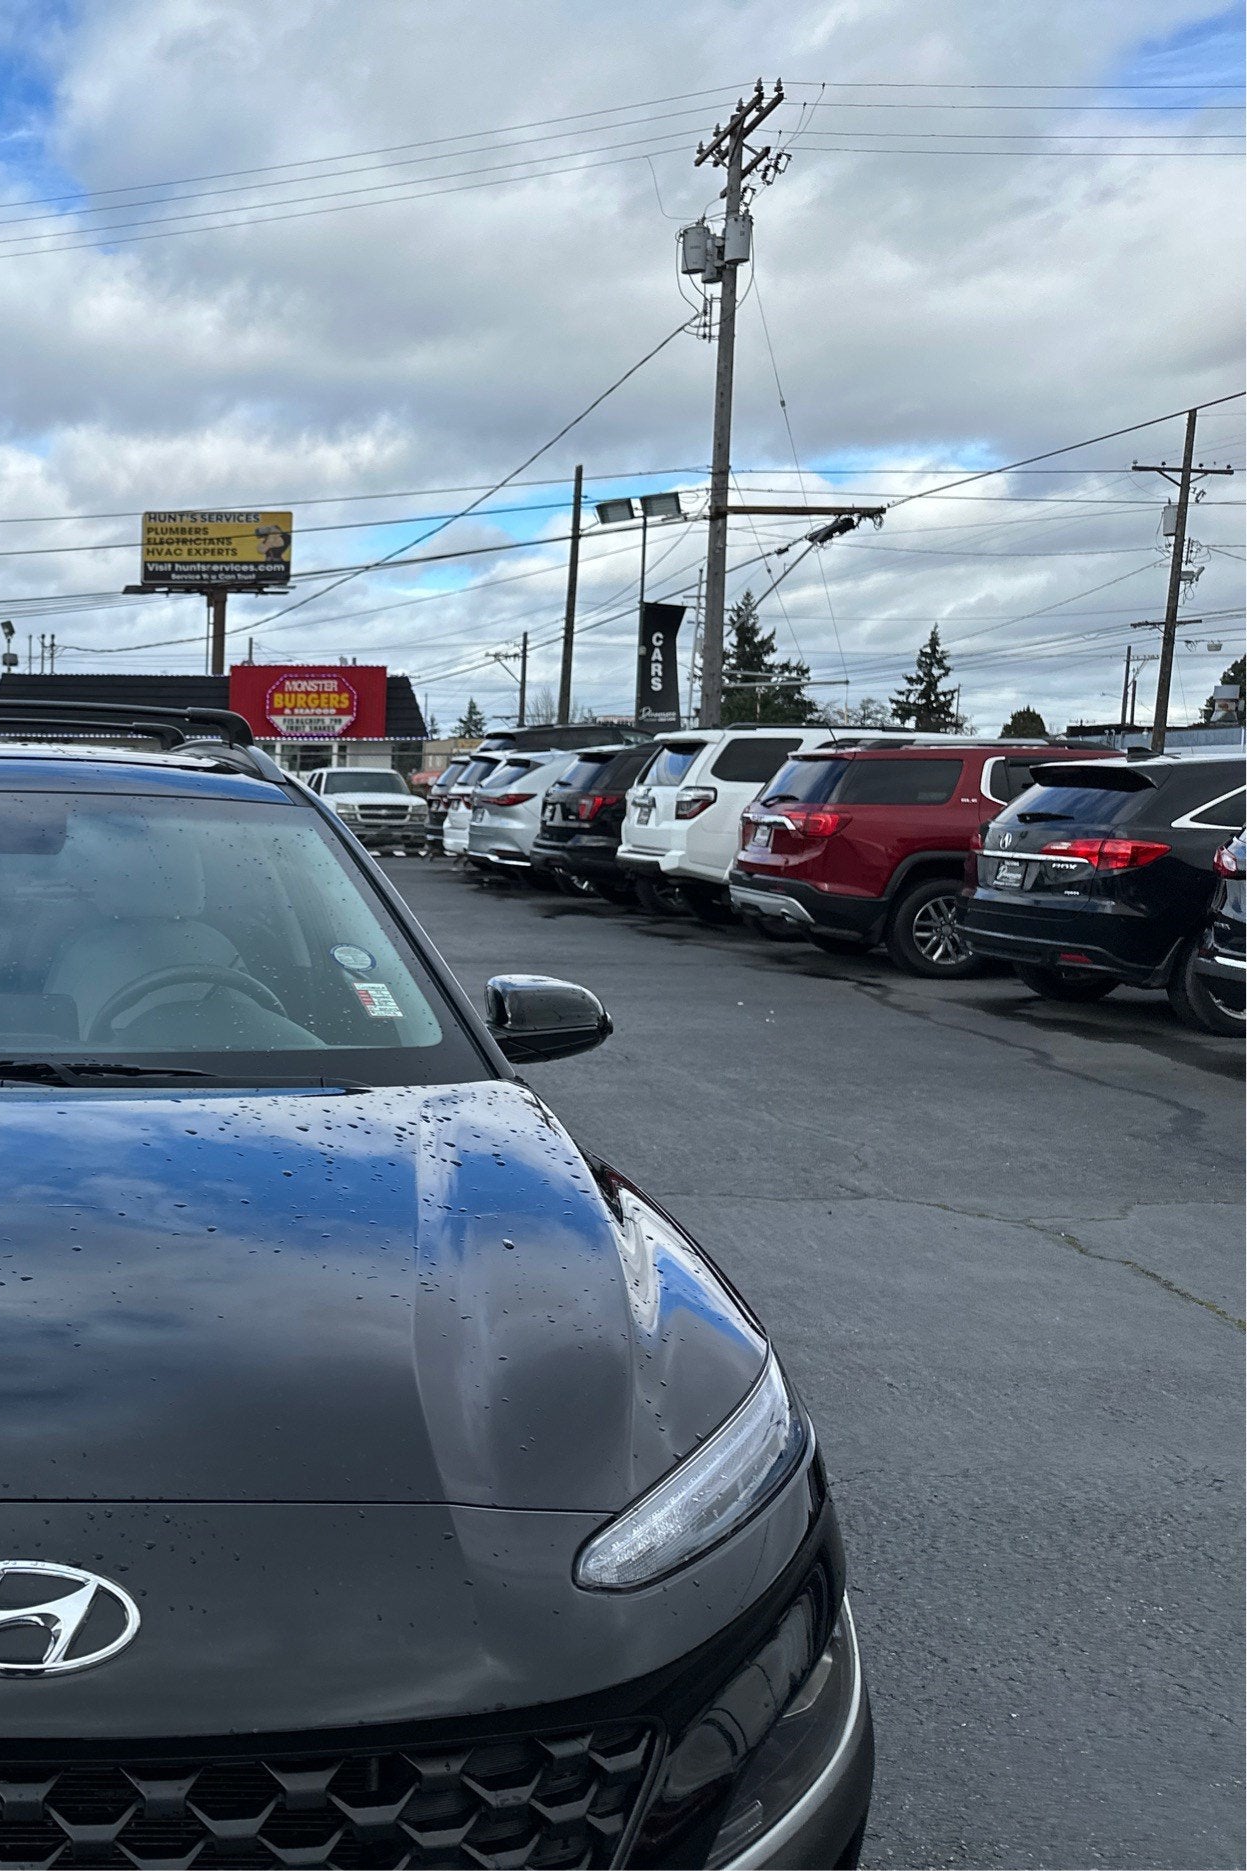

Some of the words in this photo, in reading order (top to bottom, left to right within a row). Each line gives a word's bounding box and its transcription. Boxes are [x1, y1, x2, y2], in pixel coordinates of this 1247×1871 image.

[148, 513, 197, 523] HUNT'S
[200, 513, 260, 523] SERVICES
[146, 527, 209, 536] PLUMBERS
[146, 537, 232, 547] ELECTRICIANS
[146, 548, 183, 557] HVAC
[187, 548, 238, 557] EXPERTS
[146, 562, 172, 572] Visit
[651, 631, 664, 692] CARS
[284, 680, 338, 692] MONSTER
[273, 692, 350, 709] BURGERS
